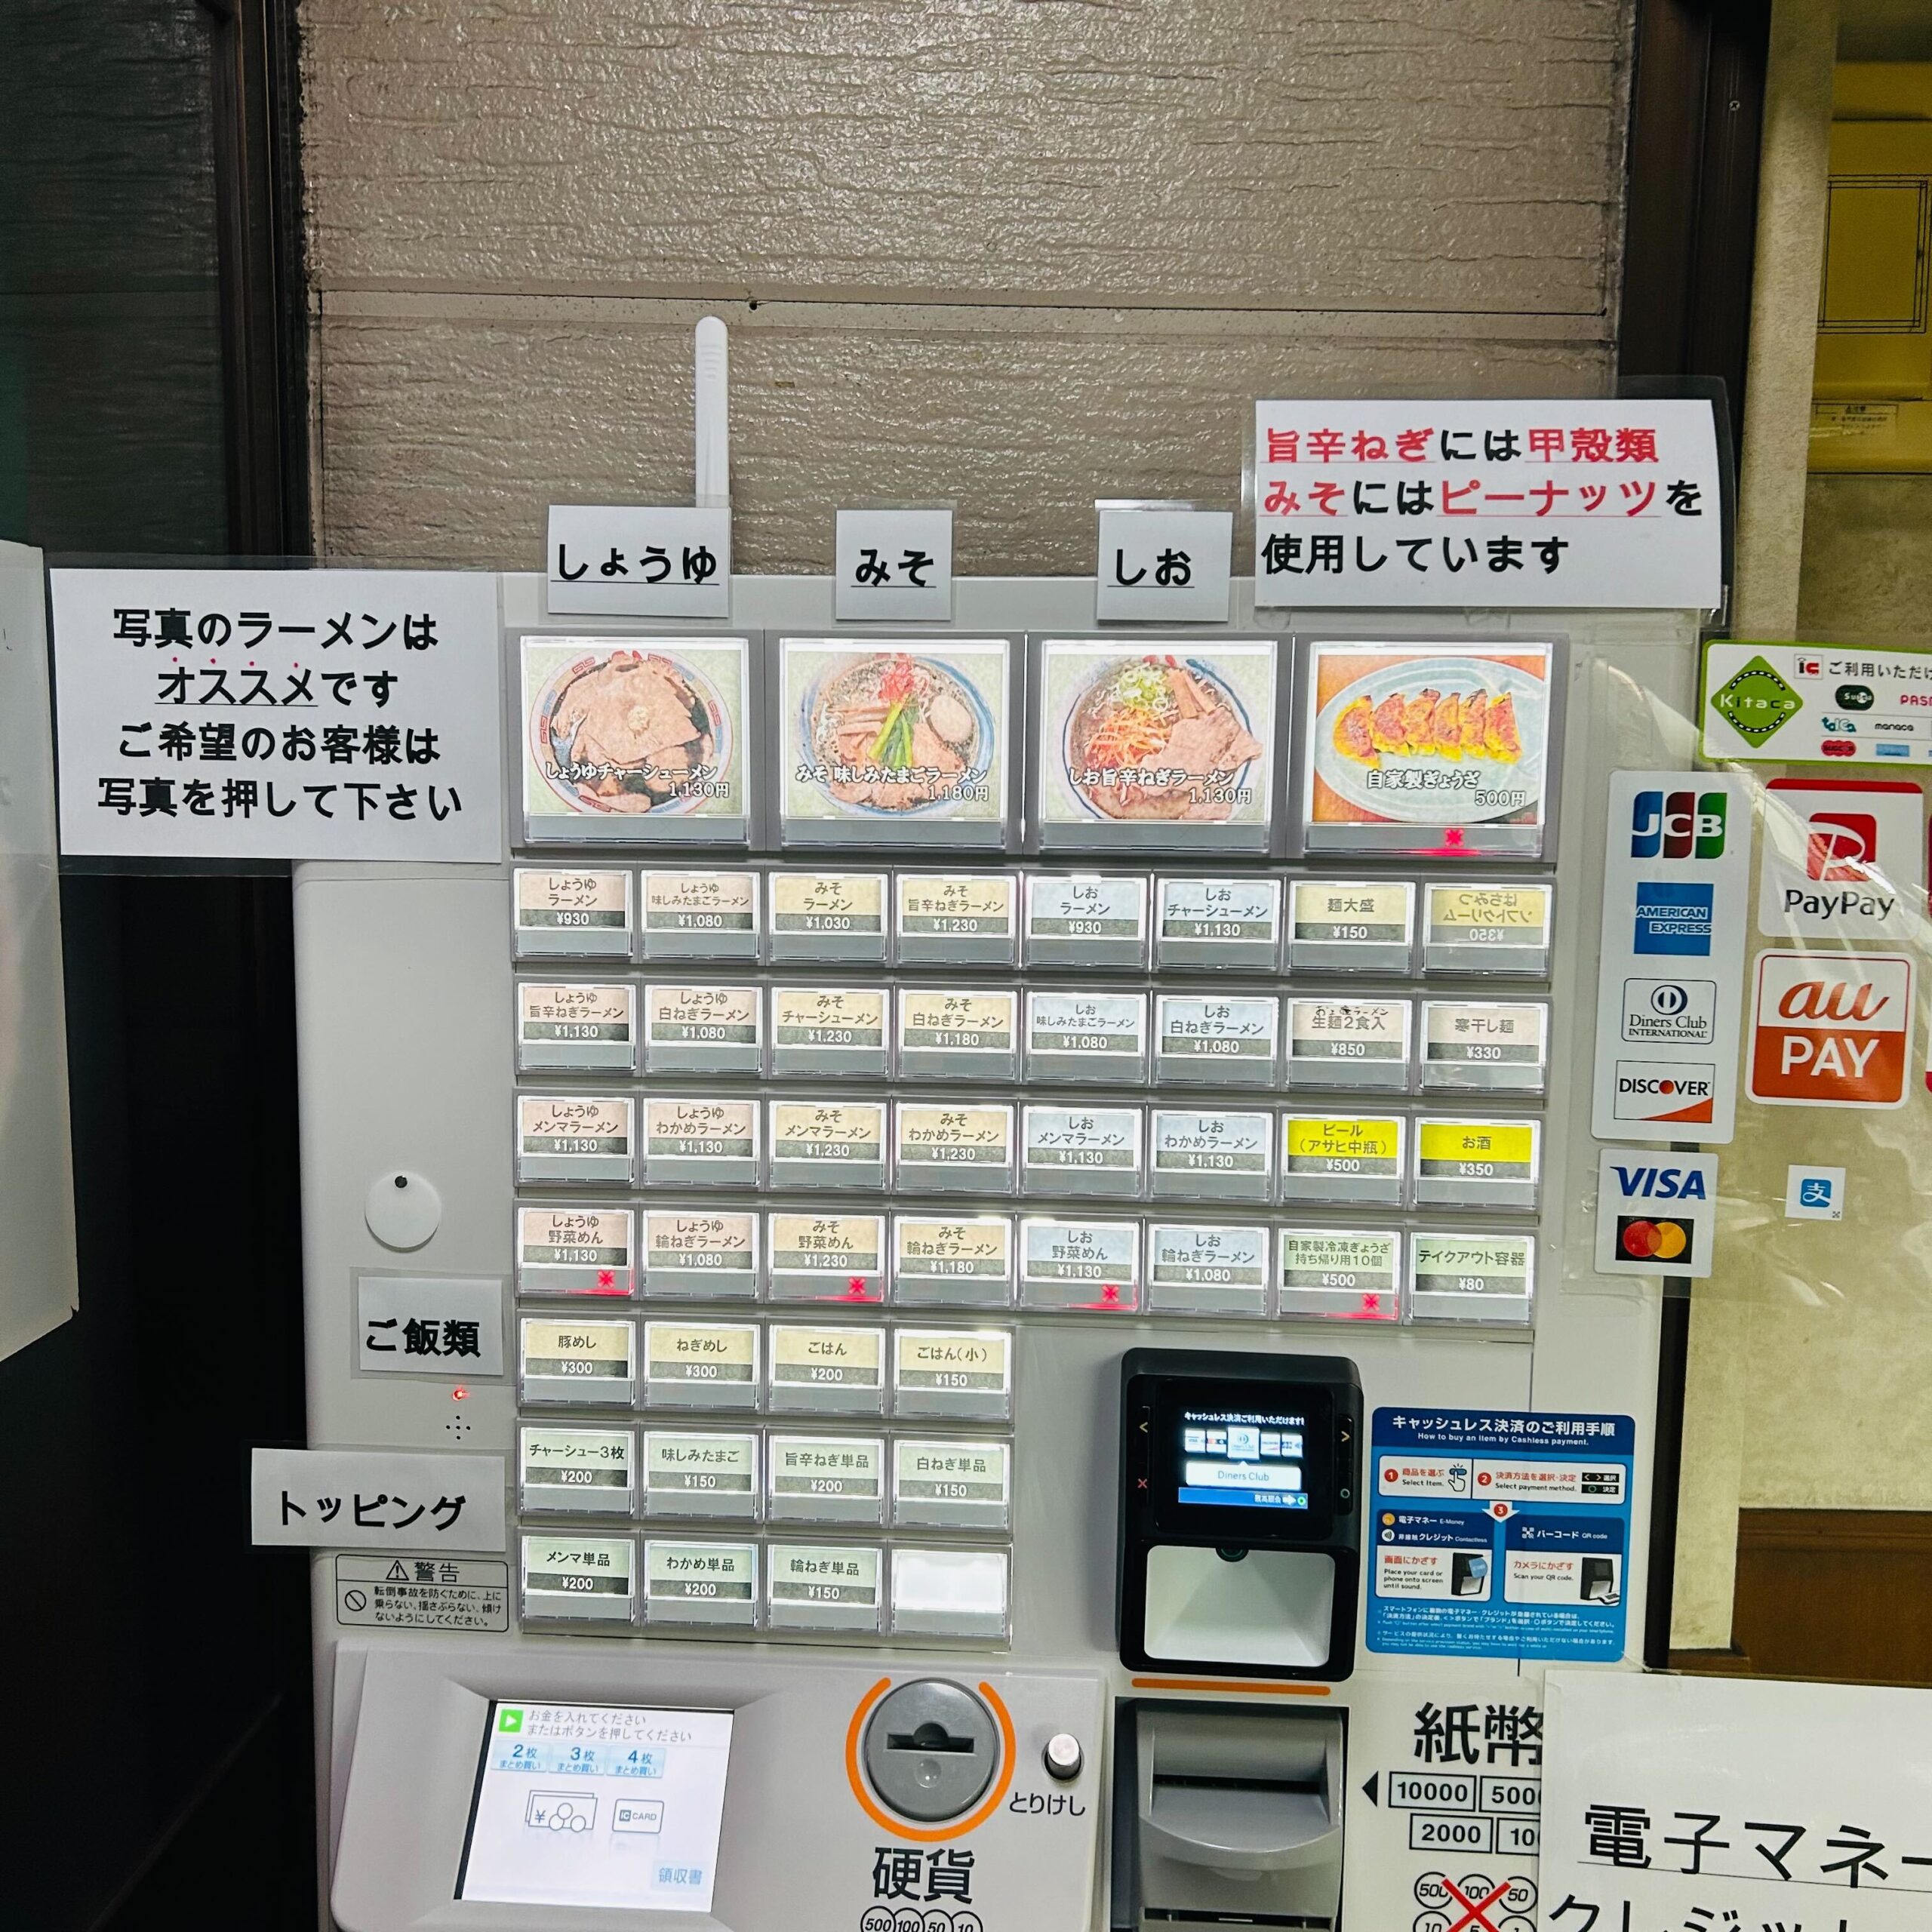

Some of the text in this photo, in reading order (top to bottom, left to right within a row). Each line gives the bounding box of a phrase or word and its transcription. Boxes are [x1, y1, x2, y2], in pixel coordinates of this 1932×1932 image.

[1268, 428, 1659, 463] 旨辛ねぎには甲殻類
[1264, 479, 1703, 516] みそにはピーナッツを
[1261, 534, 1568, 574] 使用しています
[558, 544, 717, 583] しょうゆ
[856, 549, 934, 586] みそ
[1117, 548, 1192, 586] しお
[113, 608, 438, 650] 写真のラーメンは
[157, 667, 398, 707] オススメです
[1721, 694, 1795, 709] Kitaca
[1875, 723, 1914, 731] manaca
[121, 721, 441, 765] ご希望のお客様は
[546, 764, 717, 780] しょうゆチャーシューメン
[796, 765, 987, 784] みそ 味しみたまごラーメン
[1069, 769, 1234, 787] しお旨辛ねぎラーメン
[1367, 771, 1479, 789] 自家製ぎょうざ
[669, 782, 729, 798] 1,130円
[928, 785, 989, 801] 1,180円
[1189, 788, 1252, 804] 1,130円
[98, 777, 462, 820] 写真を押して下さい
[1475, 790, 1525, 807] 500円
[1632, 814, 1722, 837] JCB
[548, 878, 597, 891] しょうゆ
[681, 883, 719, 894] しょうゆ
[814, 882, 842, 895] みそ
[944, 885, 968, 897] みそ
[548, 894, 598, 906] ラーメン
[1073, 887, 1099, 900] しお
[1205, 888, 1231, 900] しお
[651, 896, 749, 906] 味しみたまごラーメン
[803, 899, 853, 910] ラーメン
[908, 900, 1004, 912] 旨辛ねぎラーメン
[1327, 898, 1375, 913] 麺大盛
[1785, 890, 1894, 921] PayPay
[1060, 903, 1111, 915] ラーメン
[1168, 906, 1268, 918] チャーシューメン
[1637, 906, 1707, 918] AMERICAN
[557, 912, 589, 926] ¥930
[678, 914, 723, 928] ¥1,080
[806, 916, 851, 931] ¥1,030
[933, 918, 977, 933] ¥1,230
[1069, 921, 1102, 935] ¥930
[1195, 923, 1241, 937] ¥1,130
[1333, 926, 1367, 940] ¥150
[1651, 922, 1711, 934] EXPRESS
[555, 992, 598, 1004] しょうゆ
[680, 992, 728, 1005] しょうゆ
[817, 995, 844, 1008] みそ
[945, 998, 971, 1011] みそ
[1779, 981, 1890, 1021] au
[530, 1006, 624, 1019] 旨辛ねぎラーメン
[660, 1008, 749, 1021] 白ねぎラーメン
[1075, 1004, 1096, 1015] しお
[1204, 1006, 1230, 1019] しお
[783, 1011, 878, 1024] チャーシューメン
[913, 1014, 1004, 1027] 白ねぎラーメン
[1037, 1017, 1135, 1028] 味しみたまごラーメン
[1630, 1014, 1706, 1029] Diners Club
[554, 1025, 598, 1038] ¥1,130
[1171, 1020, 1264, 1035] 白ねぎラーメン
[1455, 1019, 1515, 1033] 寒干し麺
[681, 1026, 726, 1041] ¥1,080
[808, 1029, 852, 1044] ¥1,230
[935, 1032, 980, 1047] ¥1,180
[1629, 1029, 1707, 1038] INTERNATIONAL
[1063, 1035, 1108, 1050] ¥1,080
[1194, 1039, 1239, 1054] ¥1,080
[1331, 1043, 1365, 1057] ¥850
[1467, 1045, 1501, 1060] ¥330
[1782, 1036, 1879, 1078] PAY
[1620, 1078, 1709, 1096] DISCOVER
[1324, 1123, 1363, 1137] ビール
[1463, 1136, 1491, 1150] お酒
[1326, 1158, 1360, 1172] ¥500
[1459, 1163, 1494, 1177] ¥350
[1610, 1166, 1706, 1199] VISA
[1288, 1240, 1390, 1254] 自家製冷凍ぎょうざ
[1418, 1250, 1525, 1266] テイクアウト容器
[1322, 1272, 1356, 1287] ¥500
[1459, 1278, 1484, 1291] ¥80
[366, 1318, 481, 1357] ご飯類
[558, 1335, 597, 1349] 豚めし
[676, 1339, 728, 1352] ねぎめし
[808, 1342, 848, 1356] ごはん
[561, 1361, 593, 1374] ¥300
[685, 1364, 717, 1378] ¥300
[811, 1367, 843, 1381] ¥200
[935, 1374, 968, 1387] ¥150
[1392, 1417, 1615, 1436] キャッシュレス決済のご利用手順
[1499, 1435, 1509, 1444] by
[1552, 1438, 1589, 1446] payment.
[662, 1448, 740, 1463] 味しみたまご
[785, 1452, 869, 1468] 旨辛ねぎ単品
[918, 1457, 986, 1472] 白ねぎ単品
[561, 1471, 592, 1484] ¥200
[685, 1475, 716, 1488] ¥150
[1218, 1471, 1269, 1481] Diners Club
[811, 1479, 843, 1493] ¥200
[935, 1484, 968, 1497] ¥150
[281, 1491, 466, 1531] トッピング
[1399, 1516, 1437, 1524] 電子マネー
[1537, 1530, 1579, 1539] バーコード
[546, 1552, 610, 1567] メンマ単品
[667, 1556, 734, 1572] わかめ単品
[415, 1561, 460, 1583] 警告
[791, 1560, 860, 1576] 輪ねぎ単品
[561, 1577, 593, 1590] ¥200
[685, 1583, 717, 1597] ¥200
[808, 1586, 840, 1600] ¥150
[528, 1710, 645, 1724] お金を入れてください
[528, 1724, 691, 1742] またはボタンを押してください
[1414, 1702, 1543, 1766] 紙幣
[1398, 1781, 1468, 1802] 10000
[1491, 1786, 1540, 1806] 500
[1010, 1792, 1085, 1816] とりけし
[1422, 1823, 1481, 1844] 2000
[659, 1868, 702, 1884] 領収書
[873, 1847, 974, 1904] 硬貨
[1508, 1888, 1528, 1902] 50
[865, 1918, 892, 1931] 500
[898, 1920, 919, 1932] 100
[928, 1922, 945, 1932] 50
[958, 1924, 973, 1932] 10
